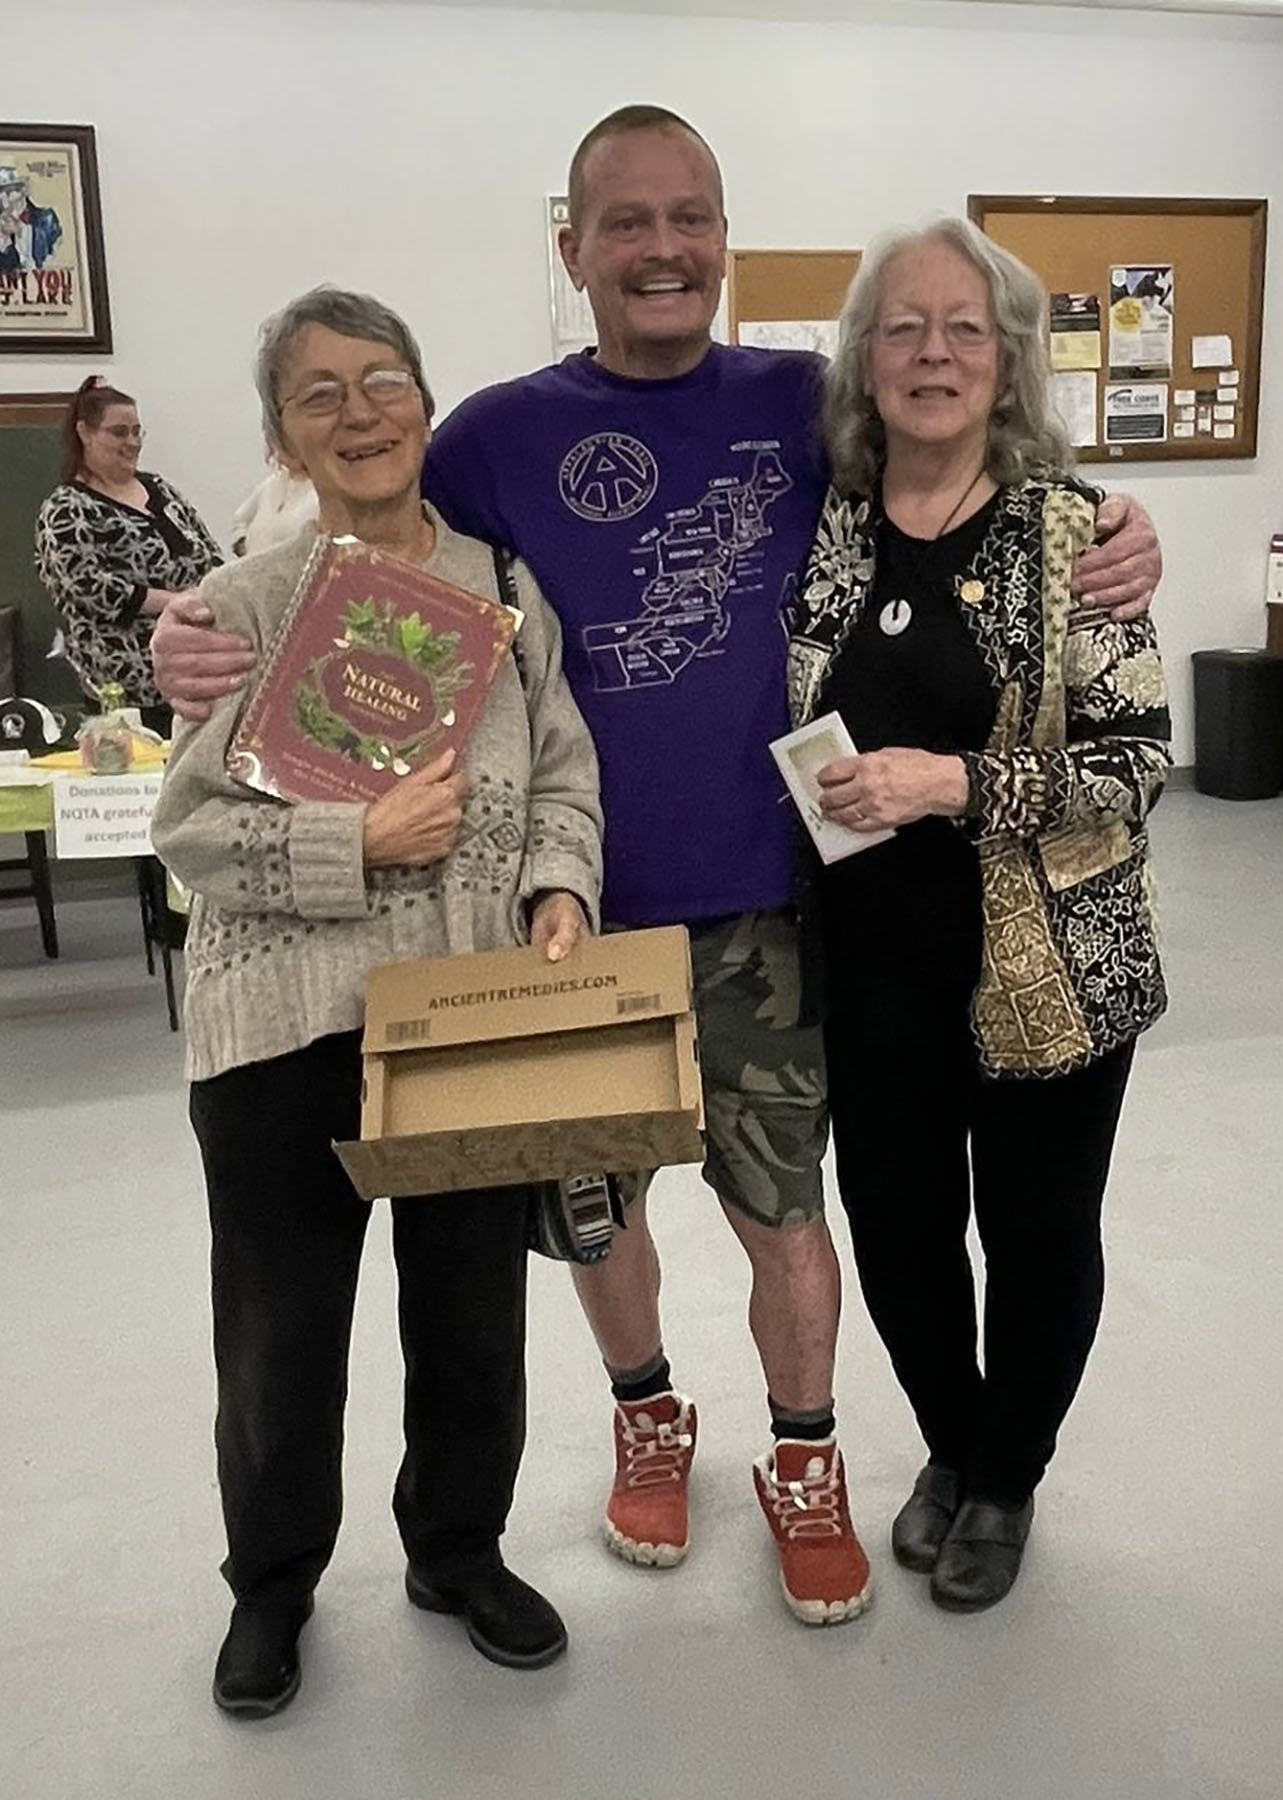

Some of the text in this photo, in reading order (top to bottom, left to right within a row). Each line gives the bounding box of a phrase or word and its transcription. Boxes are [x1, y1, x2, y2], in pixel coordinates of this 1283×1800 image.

[32, 269, 72, 290] YOU
[342, 663, 421, 712] NATURAL
[343, 685, 408, 722] HEALING
[69, 785, 141, 797] Donations
[103, 805, 153, 822] gratefu
[84, 830, 146, 842] accepted
[428, 974, 618, 1011] ANCIENTREMEDIES.COM
